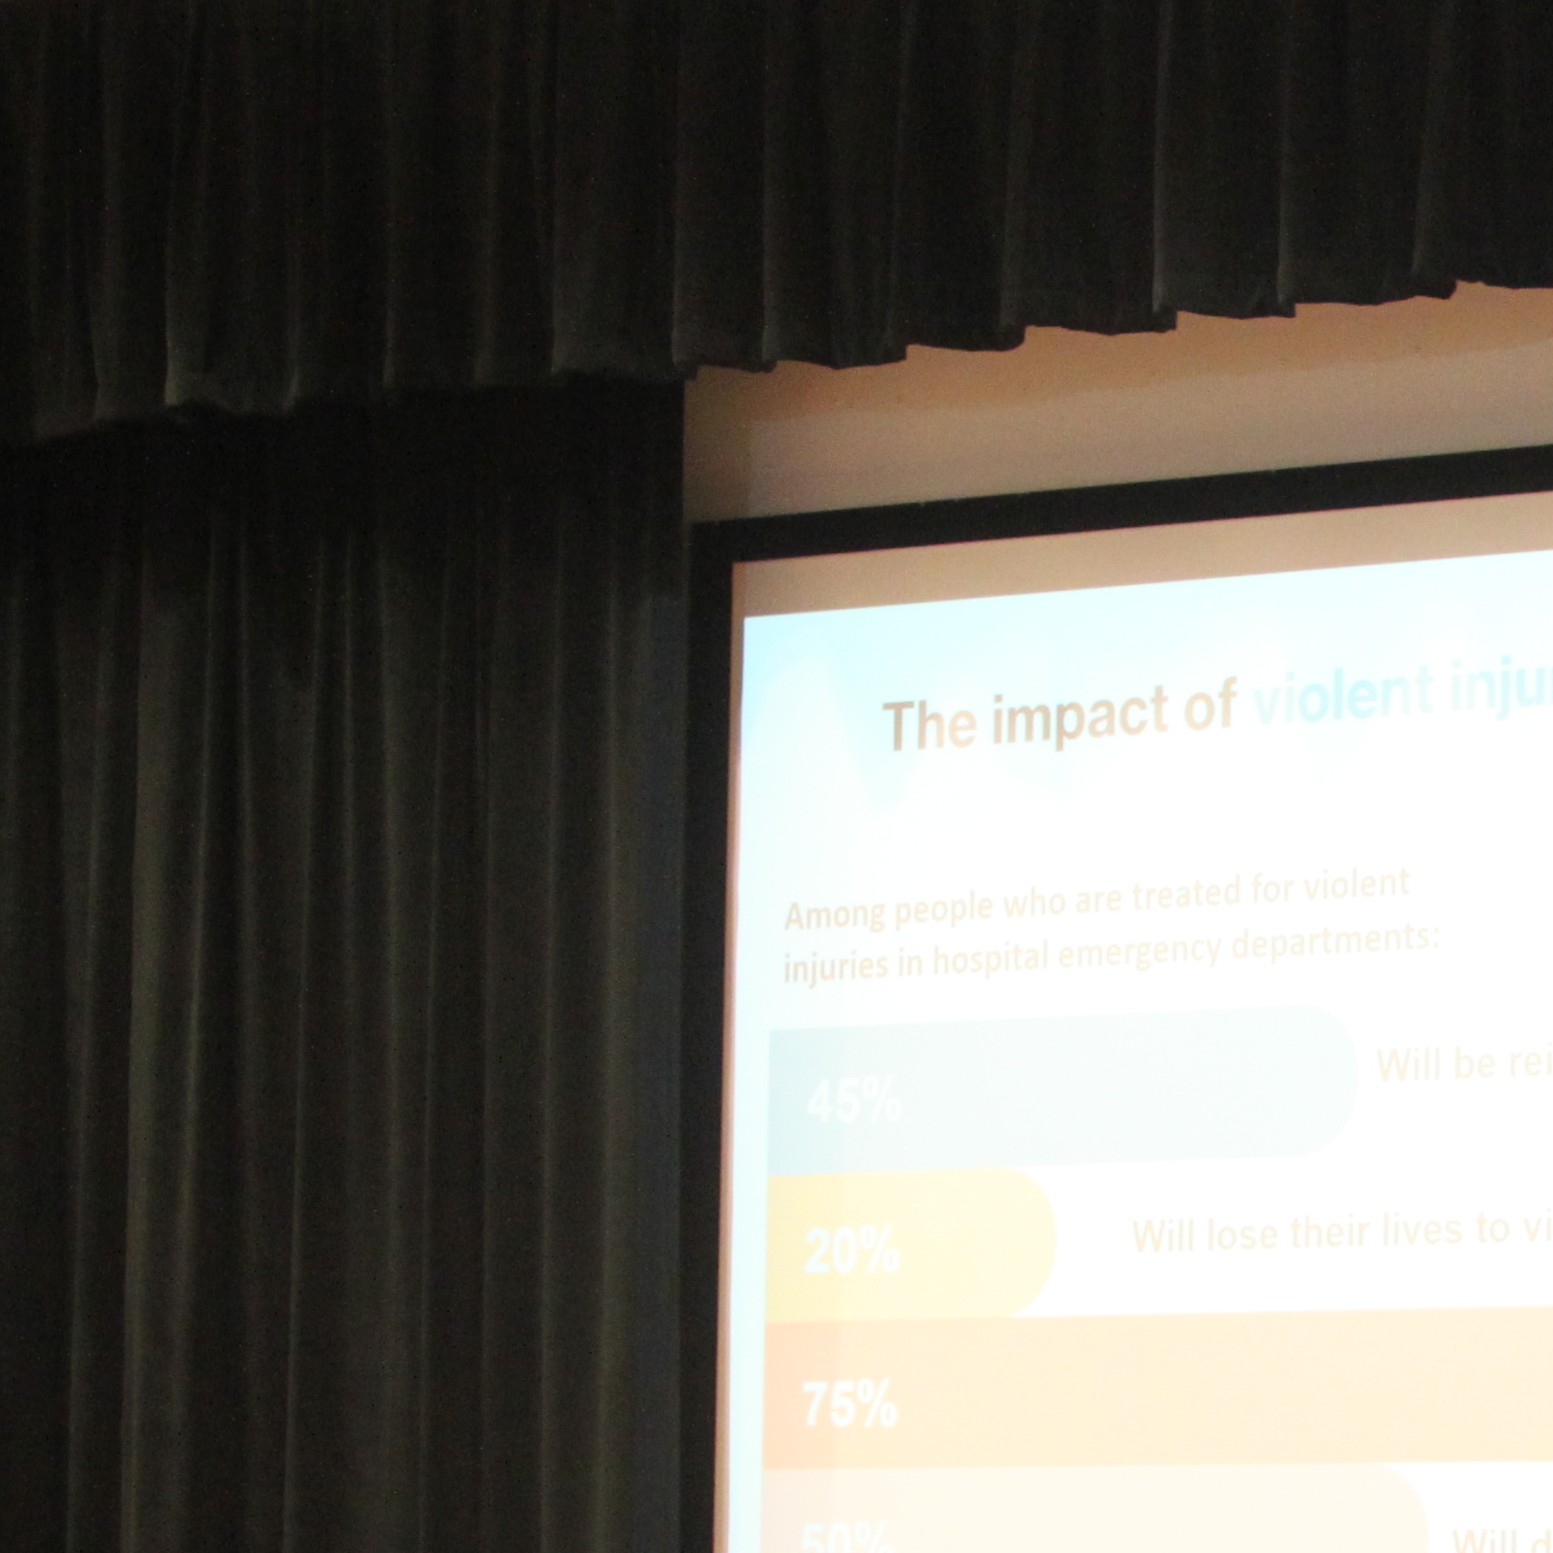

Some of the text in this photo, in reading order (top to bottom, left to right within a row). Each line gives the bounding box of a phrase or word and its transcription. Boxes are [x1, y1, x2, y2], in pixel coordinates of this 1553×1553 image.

[883, 699, 977, 752] The
[993, 685, 1168, 752] impact
[1185, 678, 1237, 733] of
[1252, 667, 1435, 726] violent
[785, 866, 1410, 933] Among people who are treated for violent
[785, 921, 1441, 989] injuries in hospital emergency departments:
[1377, 1047, 1441, 1083] Will
[1455, 1046, 1495, 1080] be
[805, 1074, 902, 1124] 45%
[803, 1224, 902, 1275] 20%
[1133, 1217, 1195, 1253] Will
[1208, 1217, 1278, 1250] lose
[1291, 1213, 1370, 1248] their
[1383, 1210, 1462, 1247] lives
[1476, 1212, 1510, 1244] to
[800, 1378, 898, 1429] 75%
